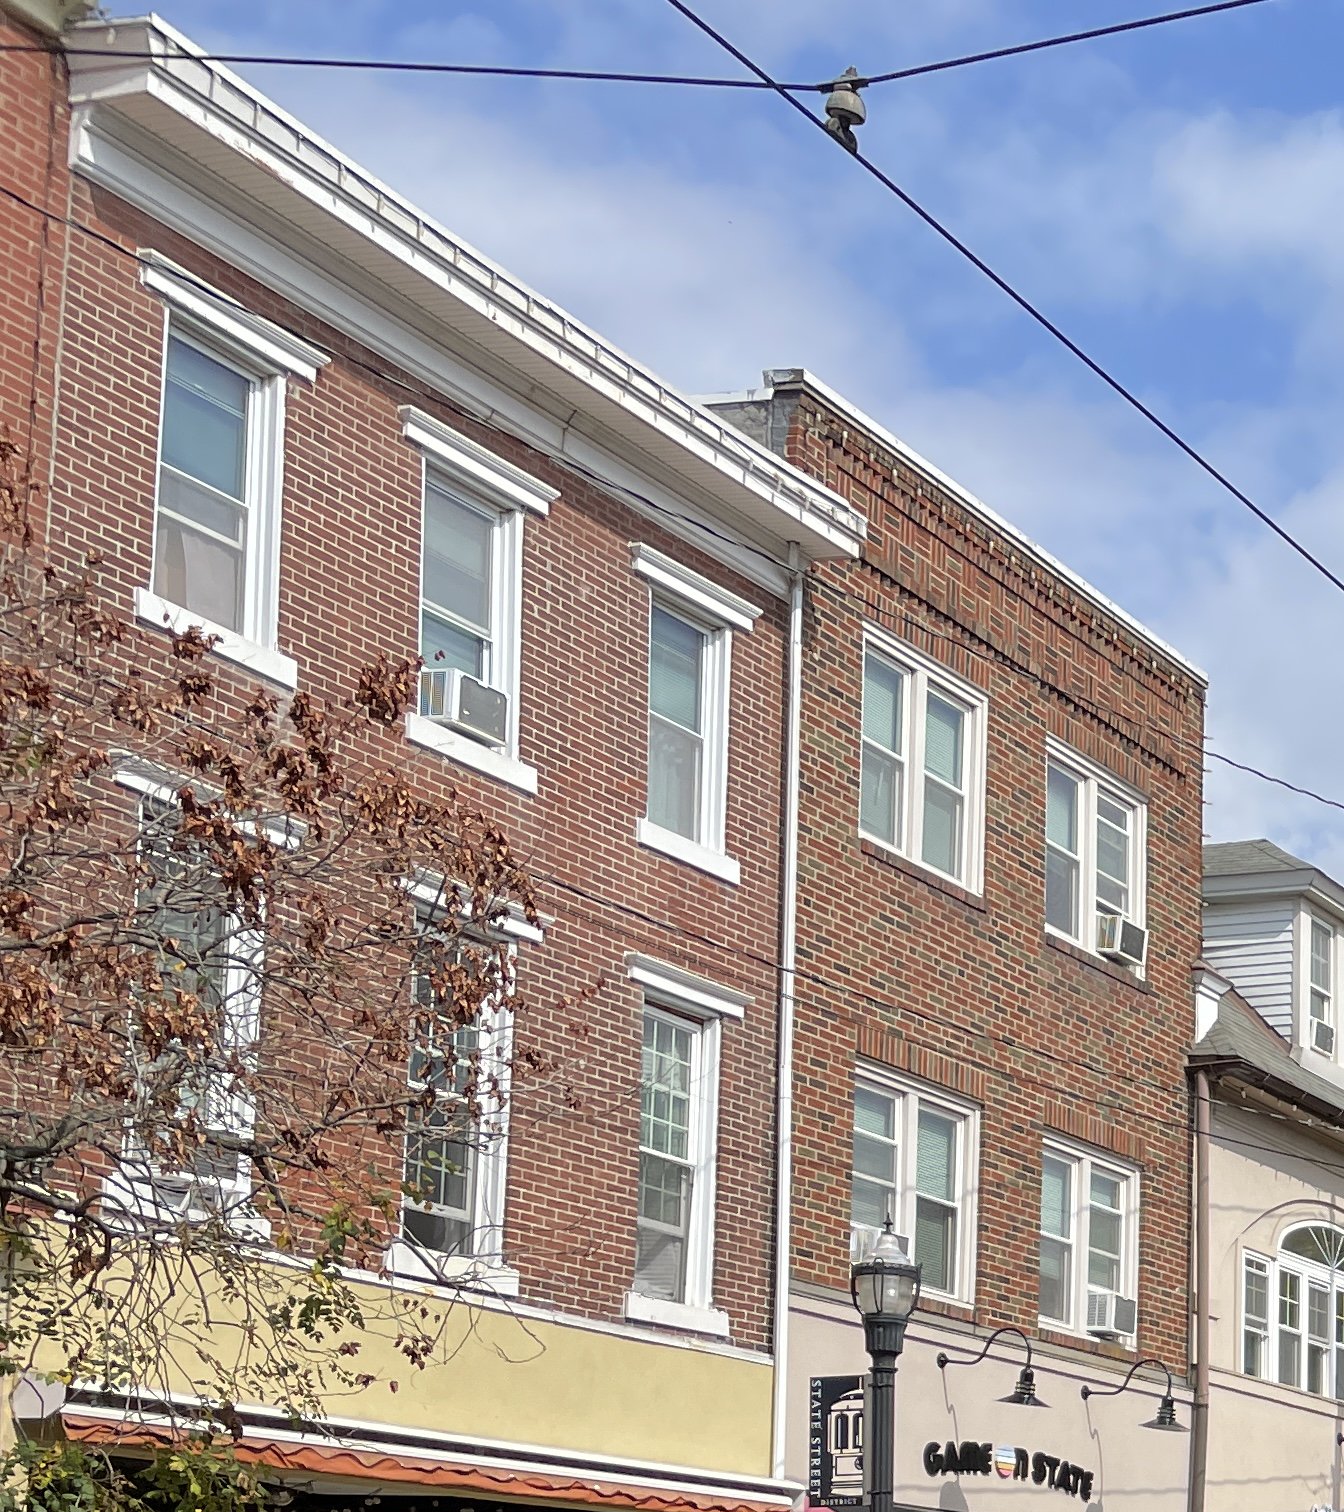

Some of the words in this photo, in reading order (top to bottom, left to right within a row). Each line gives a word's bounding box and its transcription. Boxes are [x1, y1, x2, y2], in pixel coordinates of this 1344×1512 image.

[810, 1380, 822, 1430] STATE
[810, 1437, 822, 1498] STREET
[1031, 1451, 1094, 1503] STATE
